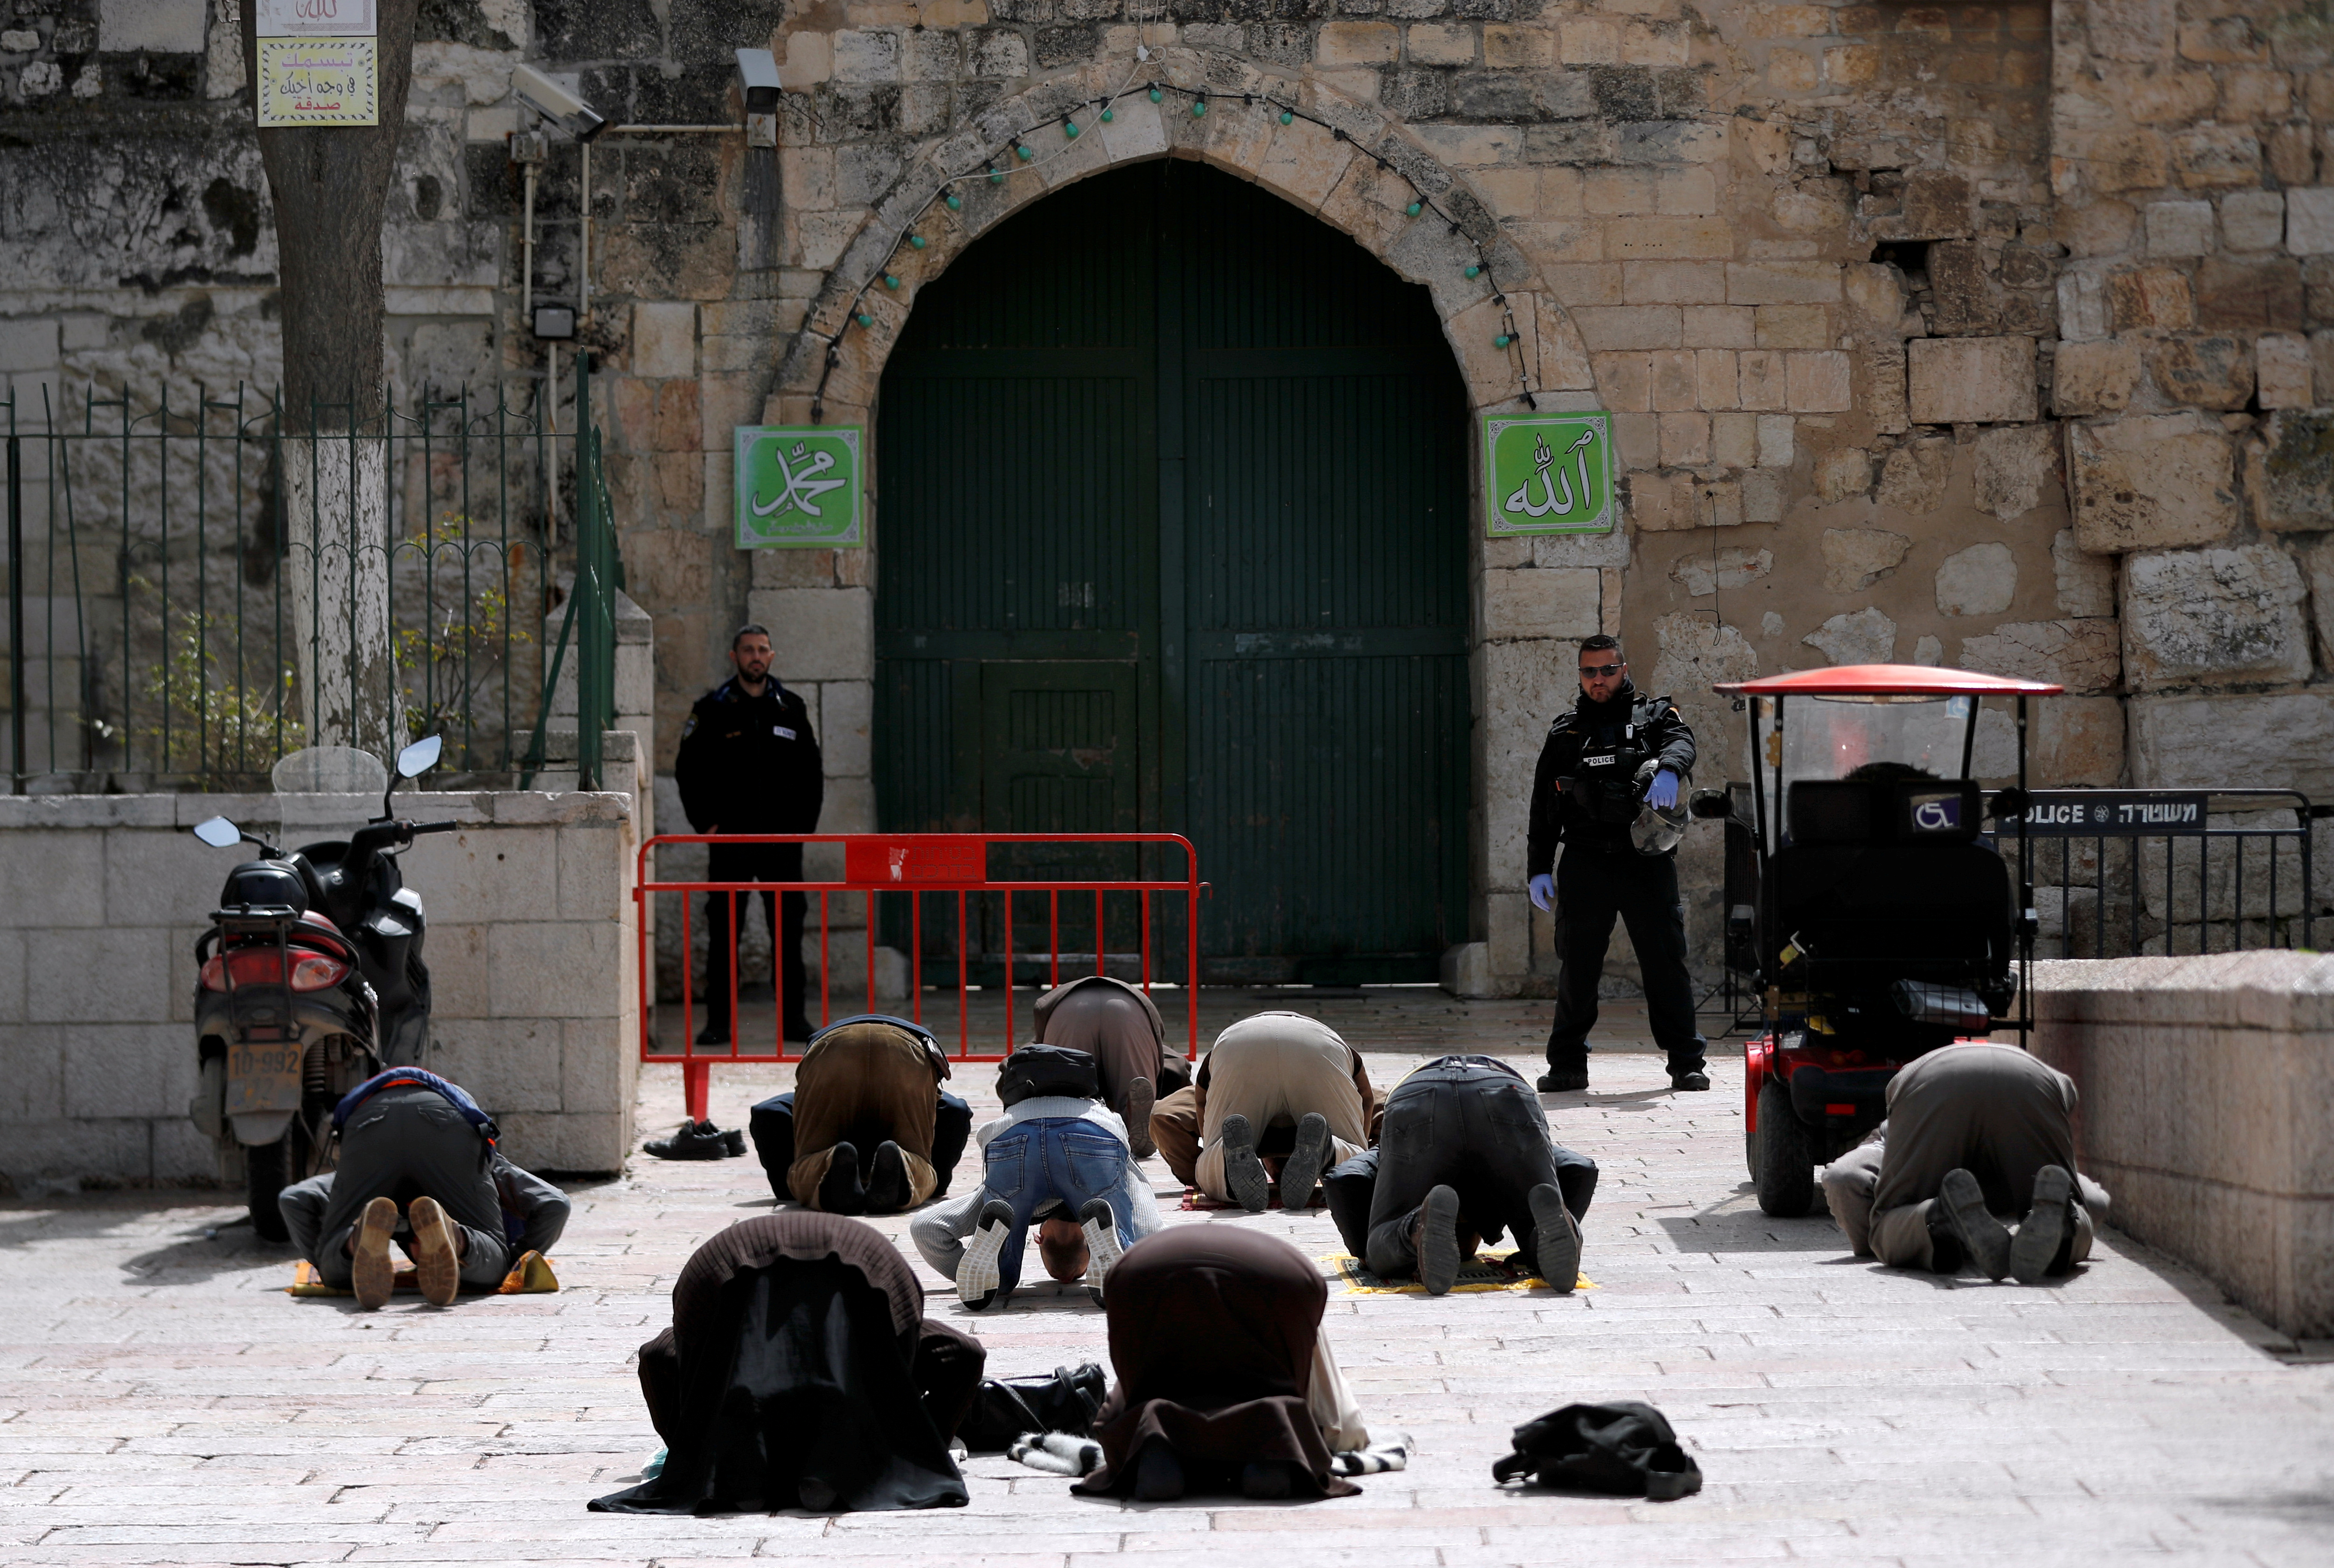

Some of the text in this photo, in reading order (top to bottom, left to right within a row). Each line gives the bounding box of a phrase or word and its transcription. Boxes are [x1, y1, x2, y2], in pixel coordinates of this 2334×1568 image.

[282, 52, 353, 72] تبسمك
[280, 71, 355, 98] في وجه أخيك
[294, 96, 341, 110] صدقة
[752, 441, 847, 517] محمد
[1505, 430, 1594, 517] الله
[2005, 804, 2084, 823] OLICE
[2118, 803, 2197, 823] משטרה
[912, 846, 977, 859] בטיחות
